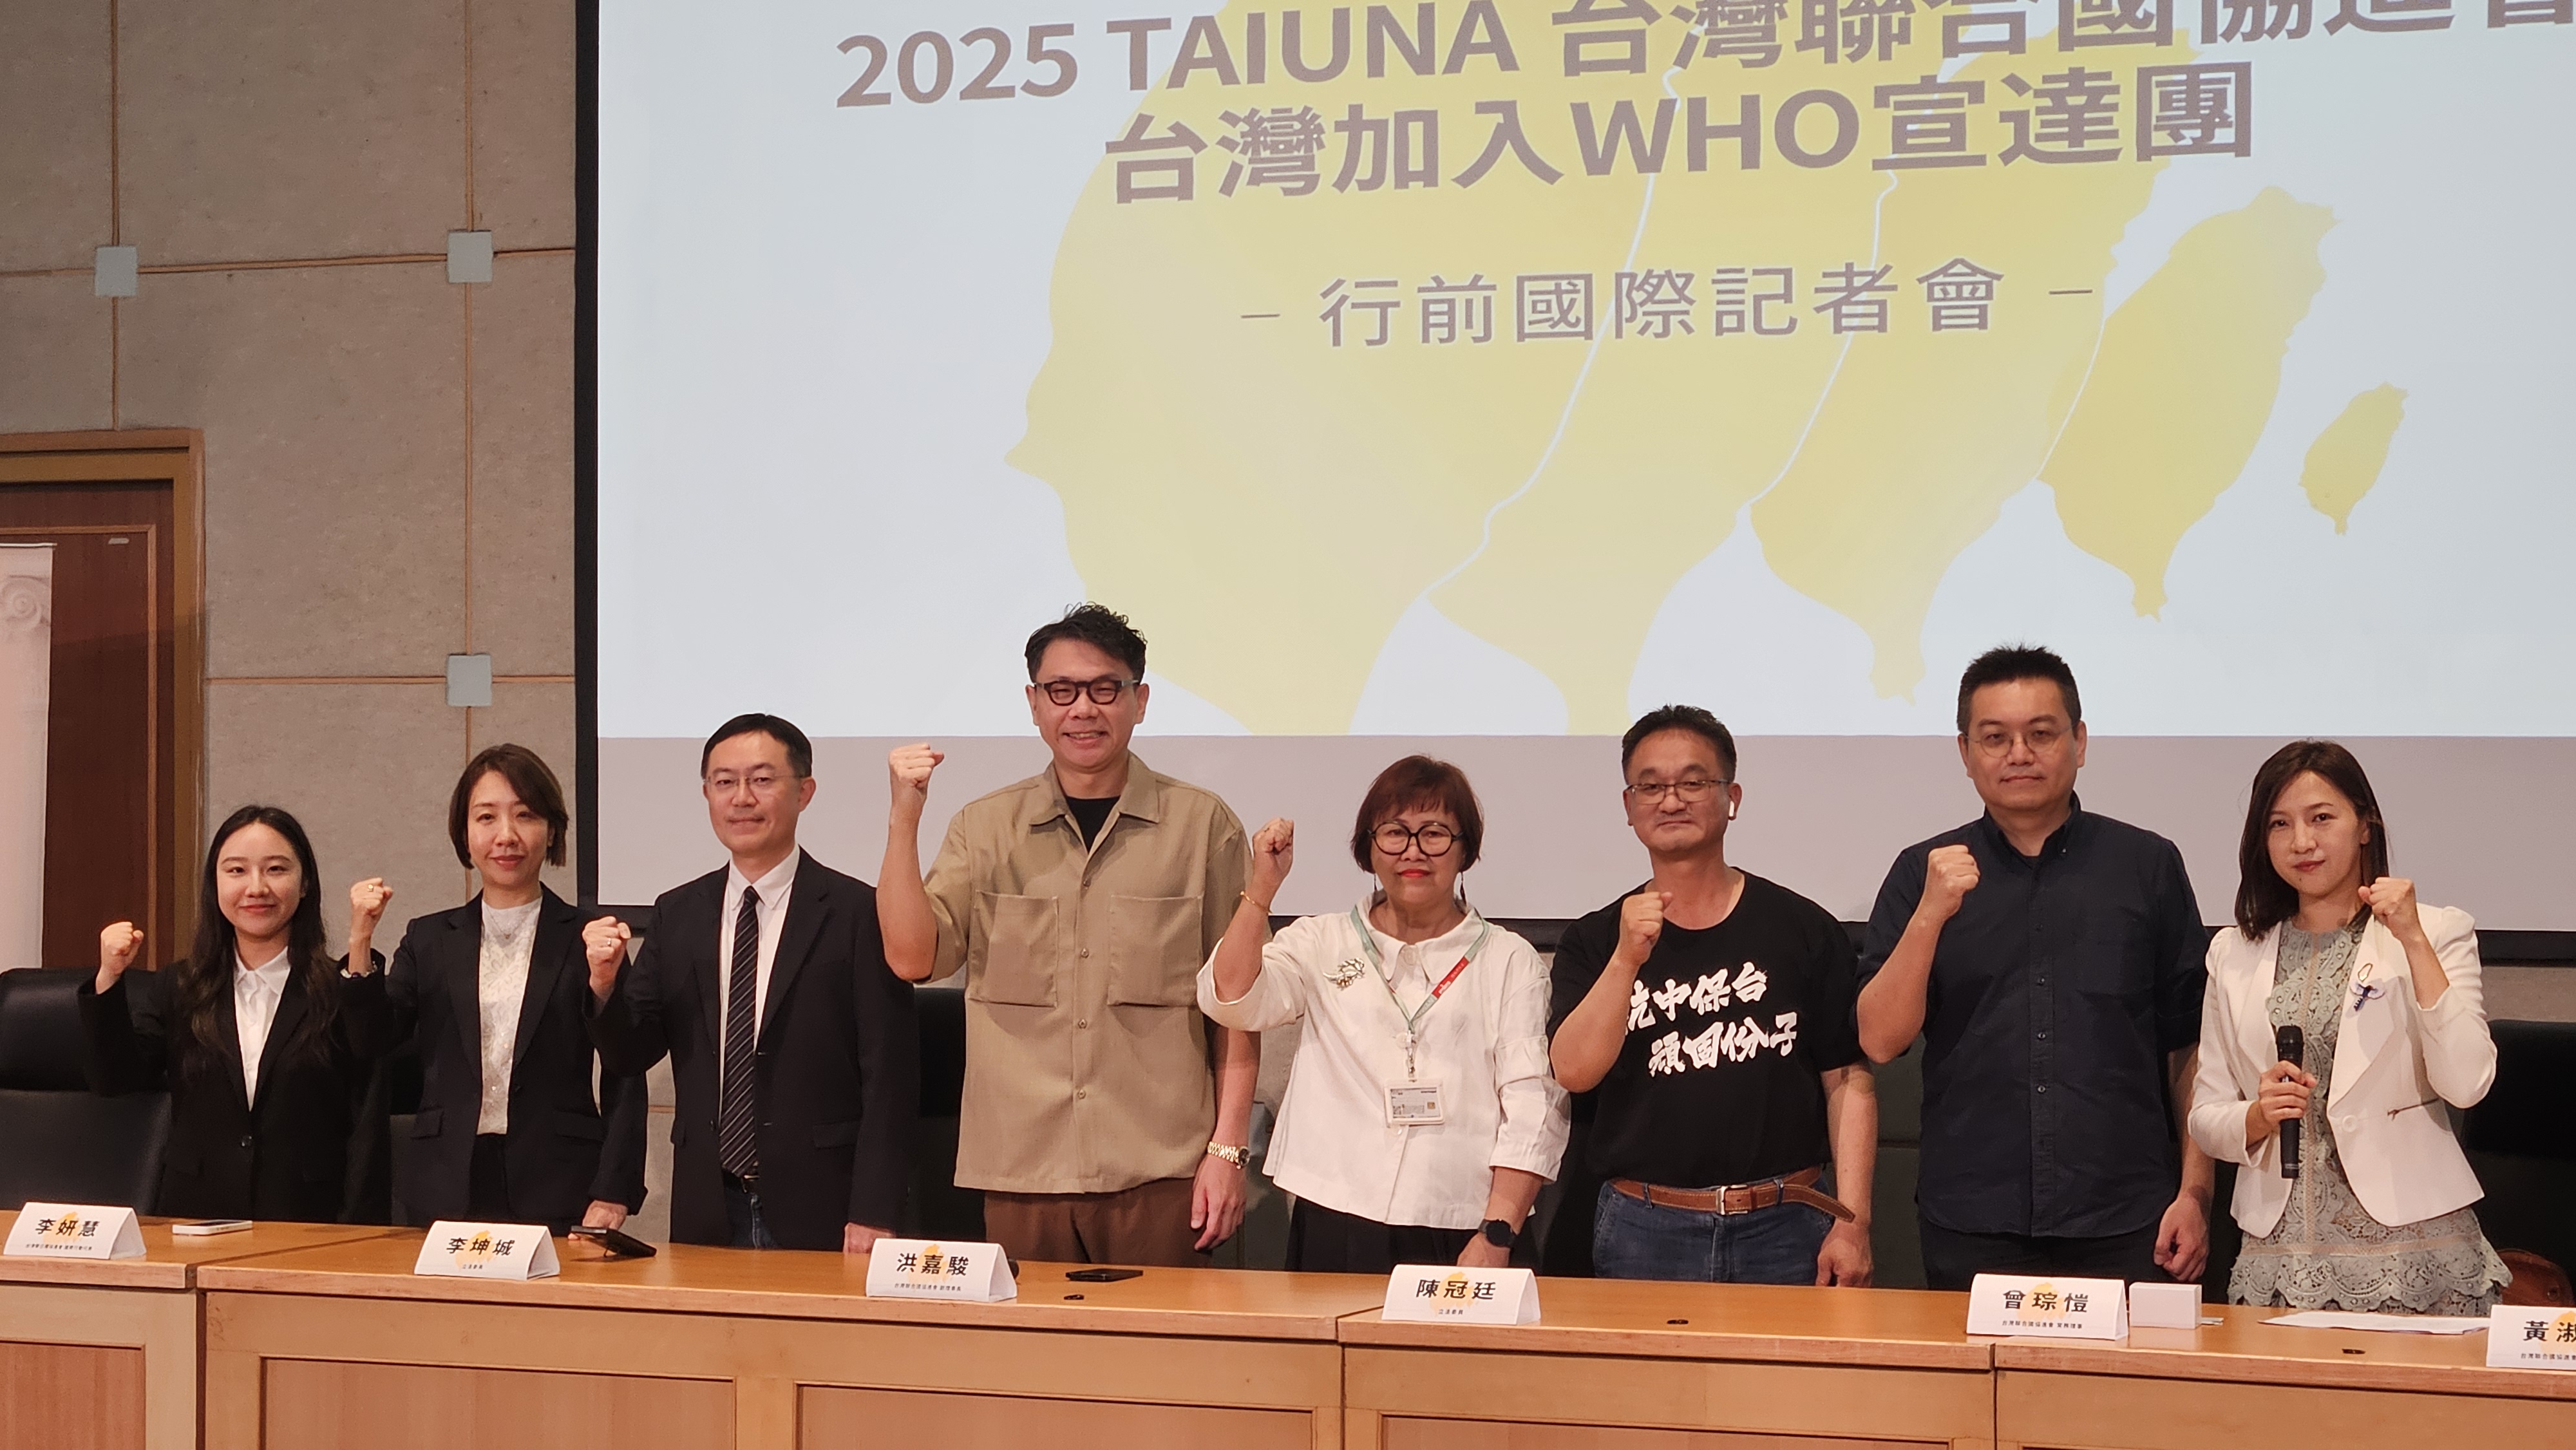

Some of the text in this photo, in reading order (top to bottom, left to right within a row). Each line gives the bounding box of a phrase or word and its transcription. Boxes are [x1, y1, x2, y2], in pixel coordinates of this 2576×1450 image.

[836, 23, 1079, 109] 2025
[1106, 0, 1520, 91] TAIUNA
[1105, 62, 2253, 205] 台灣加入WHO宣達團
[1319, 258, 2005, 348] 行前國際記者會
[1648, 1012, 1797, 1078] 頑固份子
[35, 1219, 100, 1238] 李妍慧
[446, 1238, 516, 1256] 李坤城
[896, 1253, 970, 1276] 洪嘉駿
[1416, 1279, 1497, 1300] 陳冠廷
[2003, 1290, 2089, 1313] 曾琮愷
